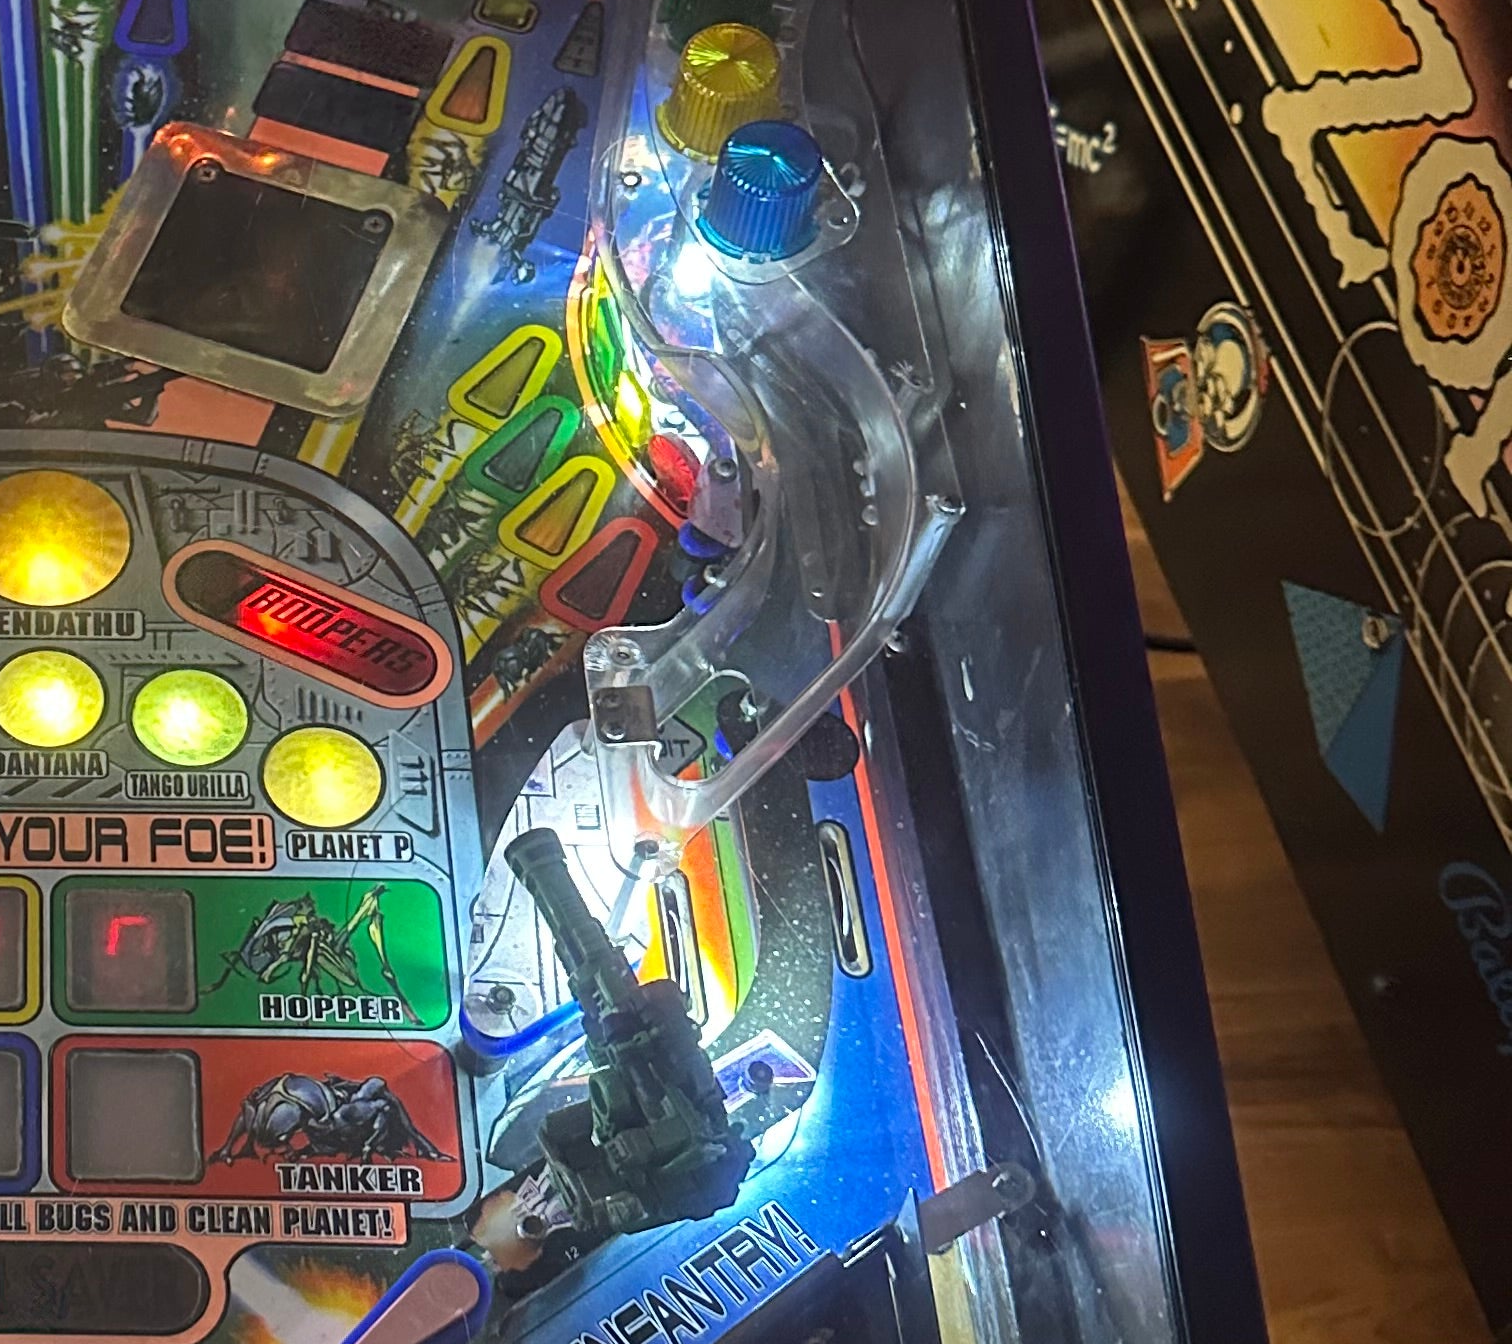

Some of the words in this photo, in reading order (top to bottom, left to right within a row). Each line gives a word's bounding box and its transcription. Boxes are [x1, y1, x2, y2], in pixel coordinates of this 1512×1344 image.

[129, 773, 184, 798] TANGO
[186, 773, 246, 799] URILLA
[149, 817, 267, 864] FOE!
[291, 833, 382, 859] PLANET
[394, 834, 410, 859] P
[259, 993, 404, 1023] HOPPER
[275, 1163, 424, 1196] TANKER
[37, 1202, 111, 1233] BUGS
[120, 1203, 178, 1233] AND
[187, 1203, 272, 1235] CLEAN
[282, 1205, 394, 1237] PLANET!
